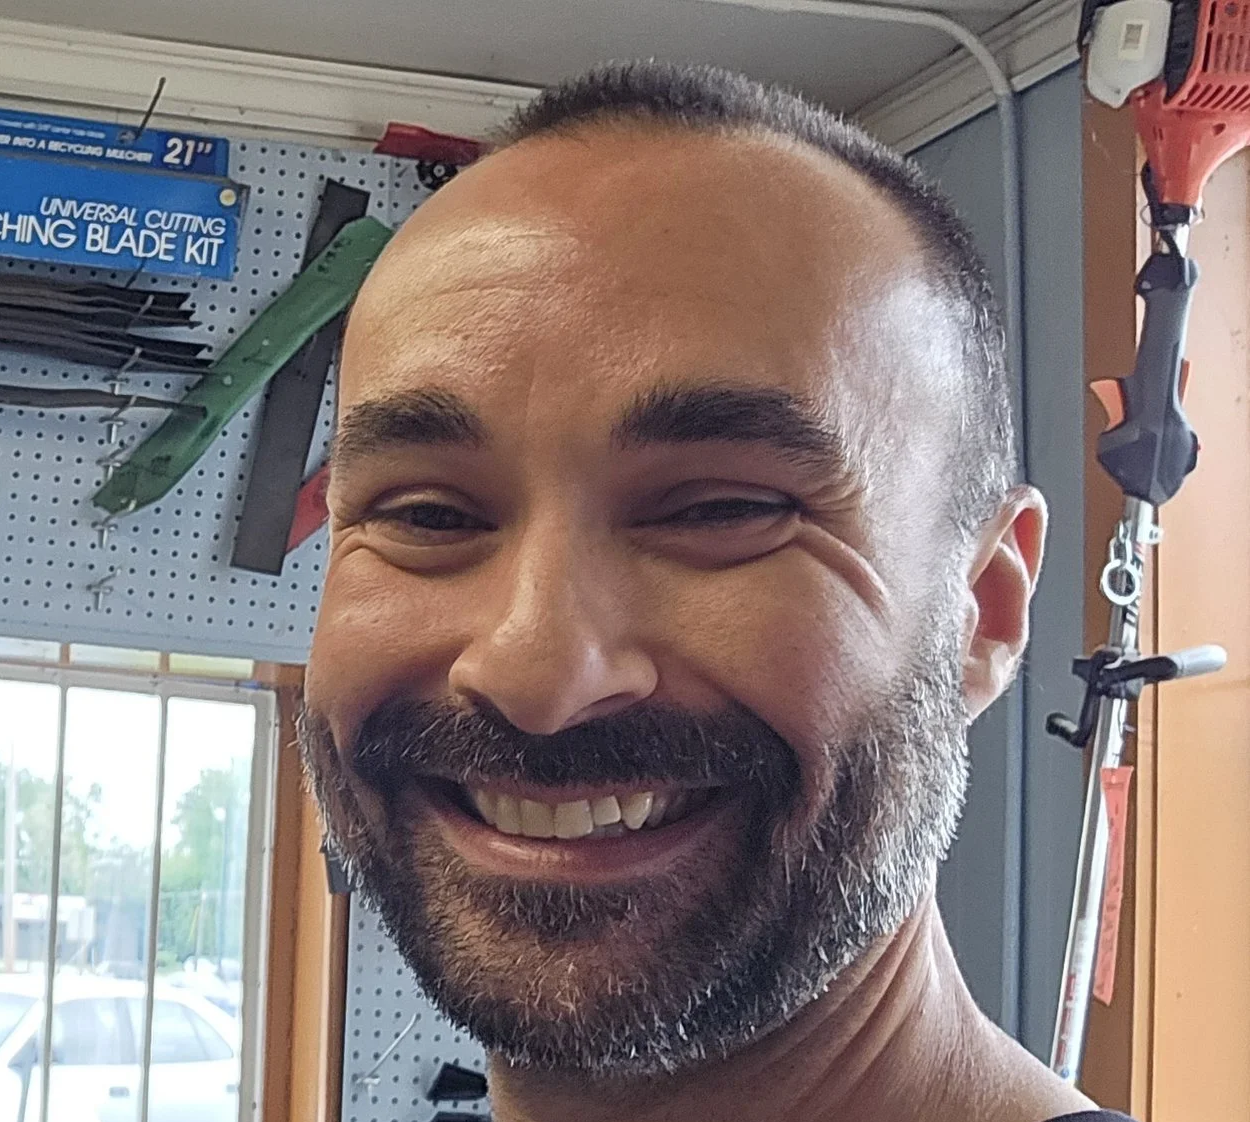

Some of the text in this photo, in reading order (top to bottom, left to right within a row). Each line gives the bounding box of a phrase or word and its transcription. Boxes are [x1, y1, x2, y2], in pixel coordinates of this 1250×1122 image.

[13, 136, 35, 148] INTO
[37, 139, 46, 150] A
[49, 141, 103, 157] RECYCLING
[106, 148, 153, 163] MULCHER
[39, 196, 227, 236] UNIVERSAL CUTTING
[85, 223, 177, 262] BLADE
[184, 235, 225, 267] KIT
